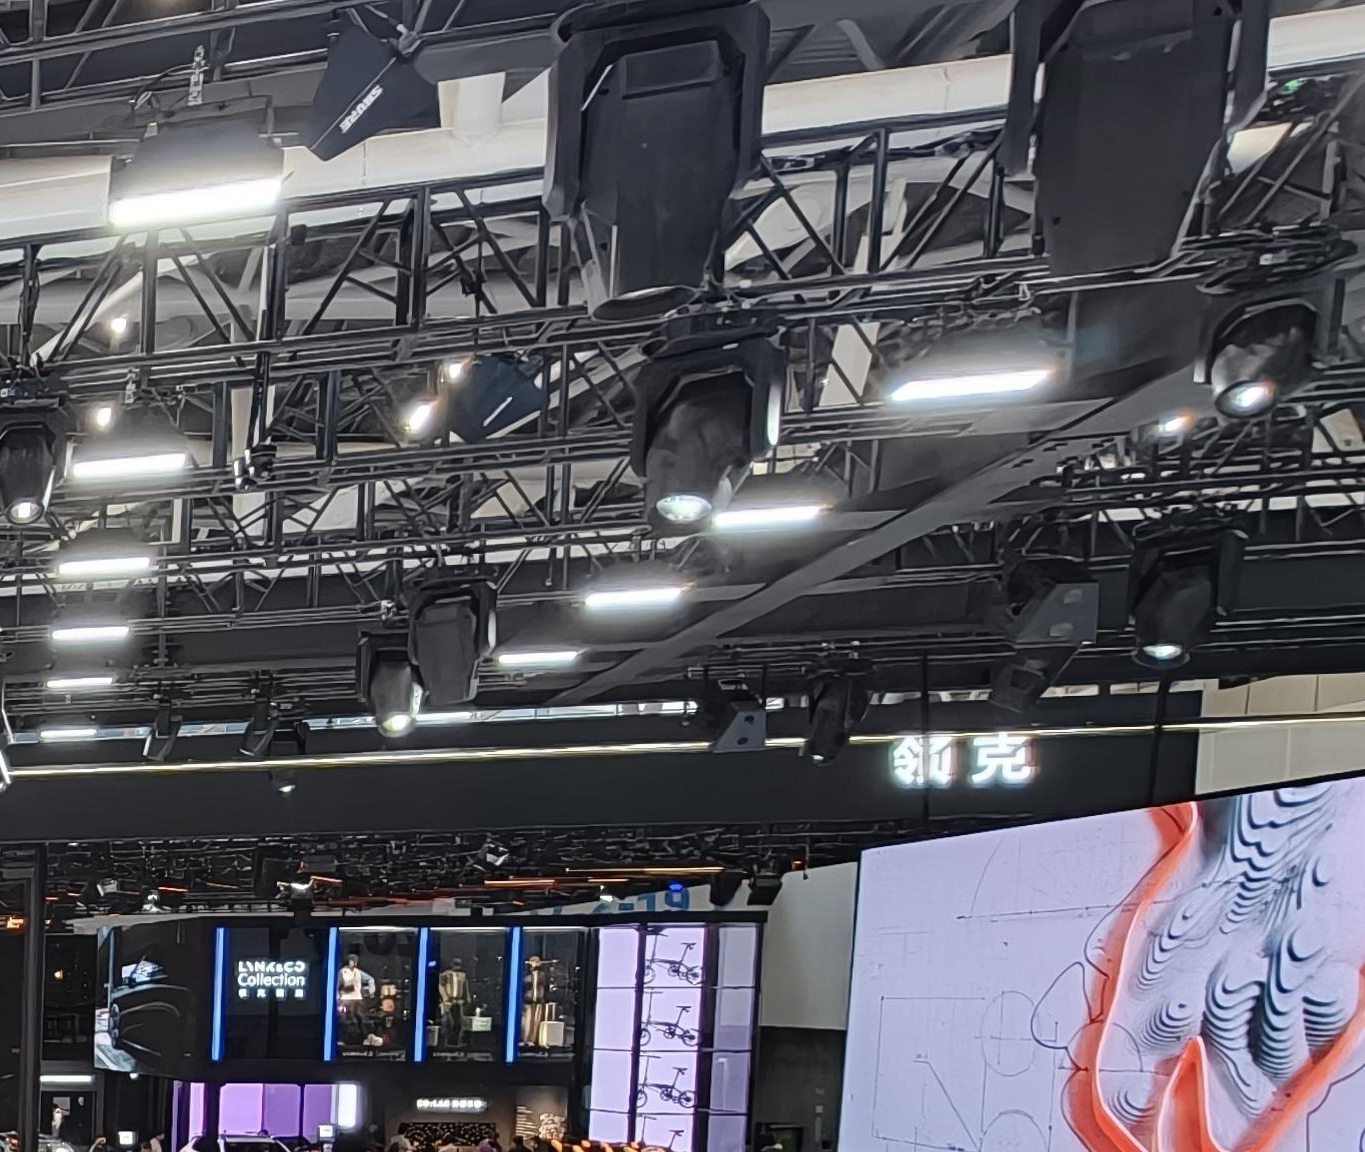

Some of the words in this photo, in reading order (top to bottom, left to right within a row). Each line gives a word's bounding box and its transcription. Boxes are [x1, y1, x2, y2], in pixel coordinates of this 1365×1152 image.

[339, 85, 383, 134] SHURE
[893, 733, 1032, 785] 领克
[237, 972, 306, 987] Collection
